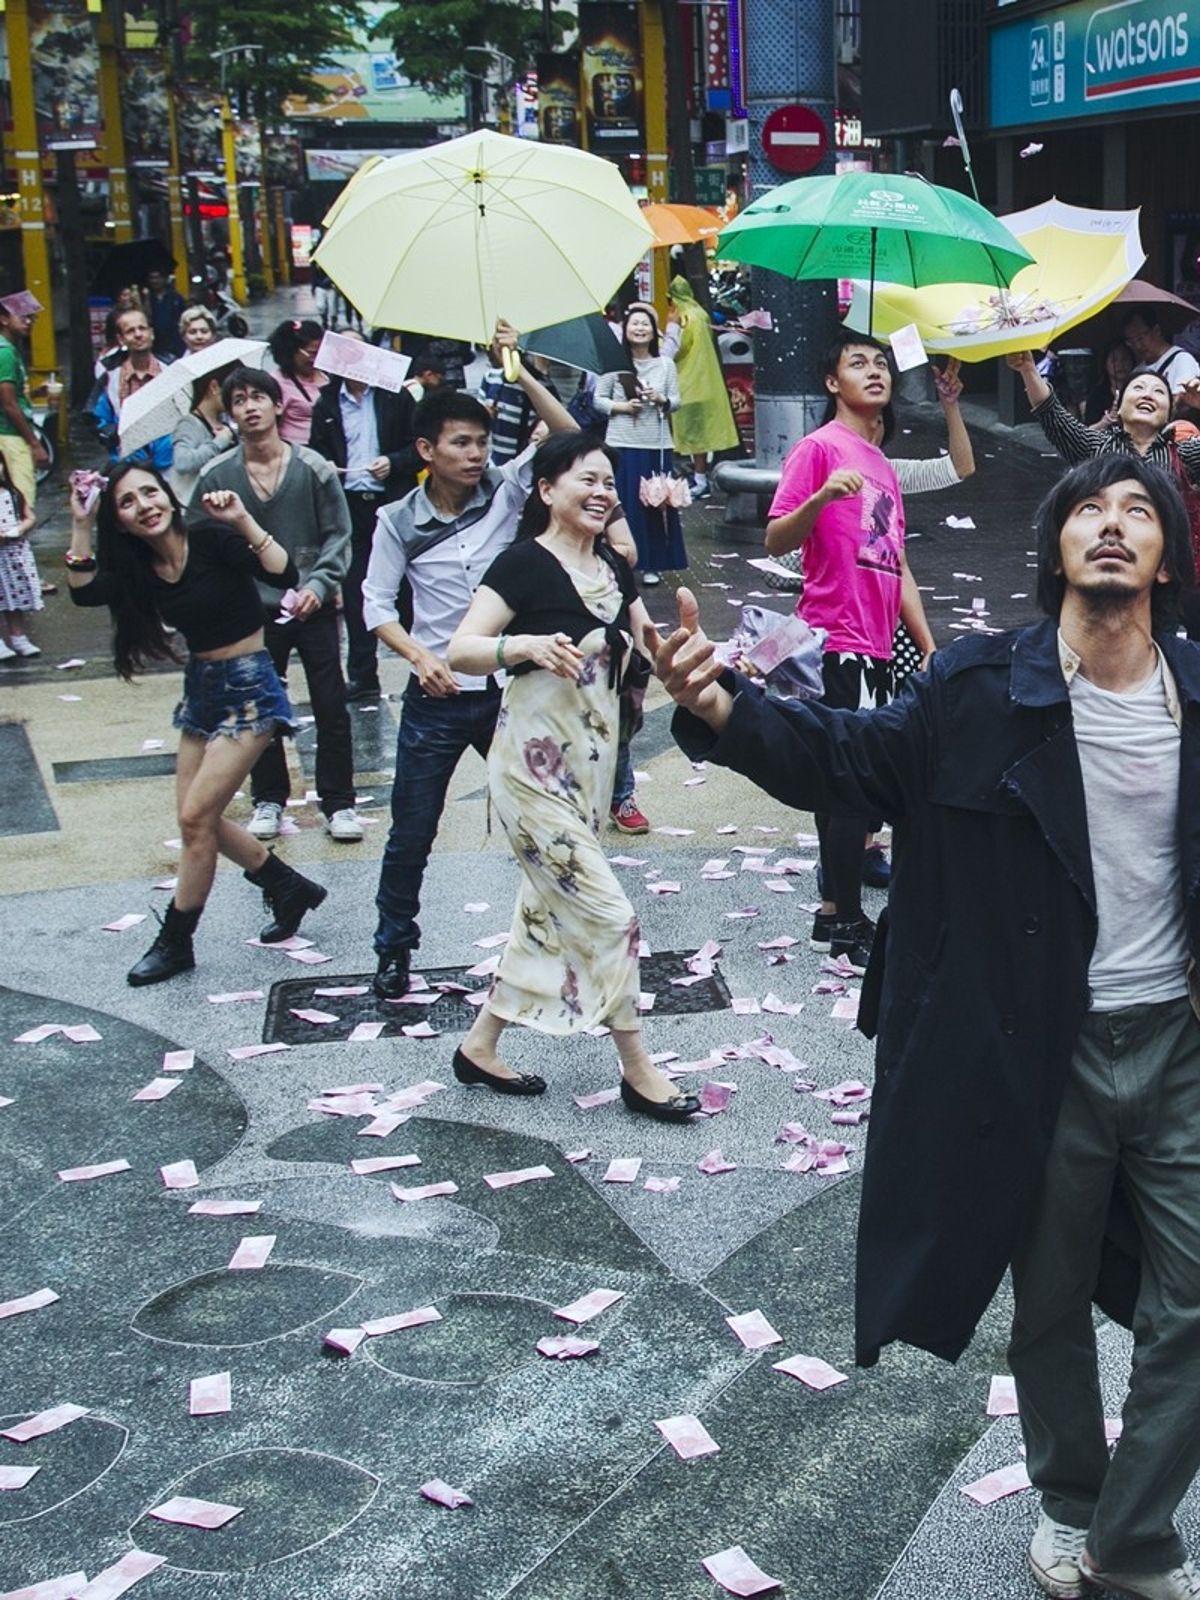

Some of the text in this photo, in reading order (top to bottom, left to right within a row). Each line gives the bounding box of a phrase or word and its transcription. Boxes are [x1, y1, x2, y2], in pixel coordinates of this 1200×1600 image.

[1096, 12, 1188, 72] watsons
[22, 170, 36, 186] H
[652, 170, 664, 187] H
[22, 198, 42, 211] 12
